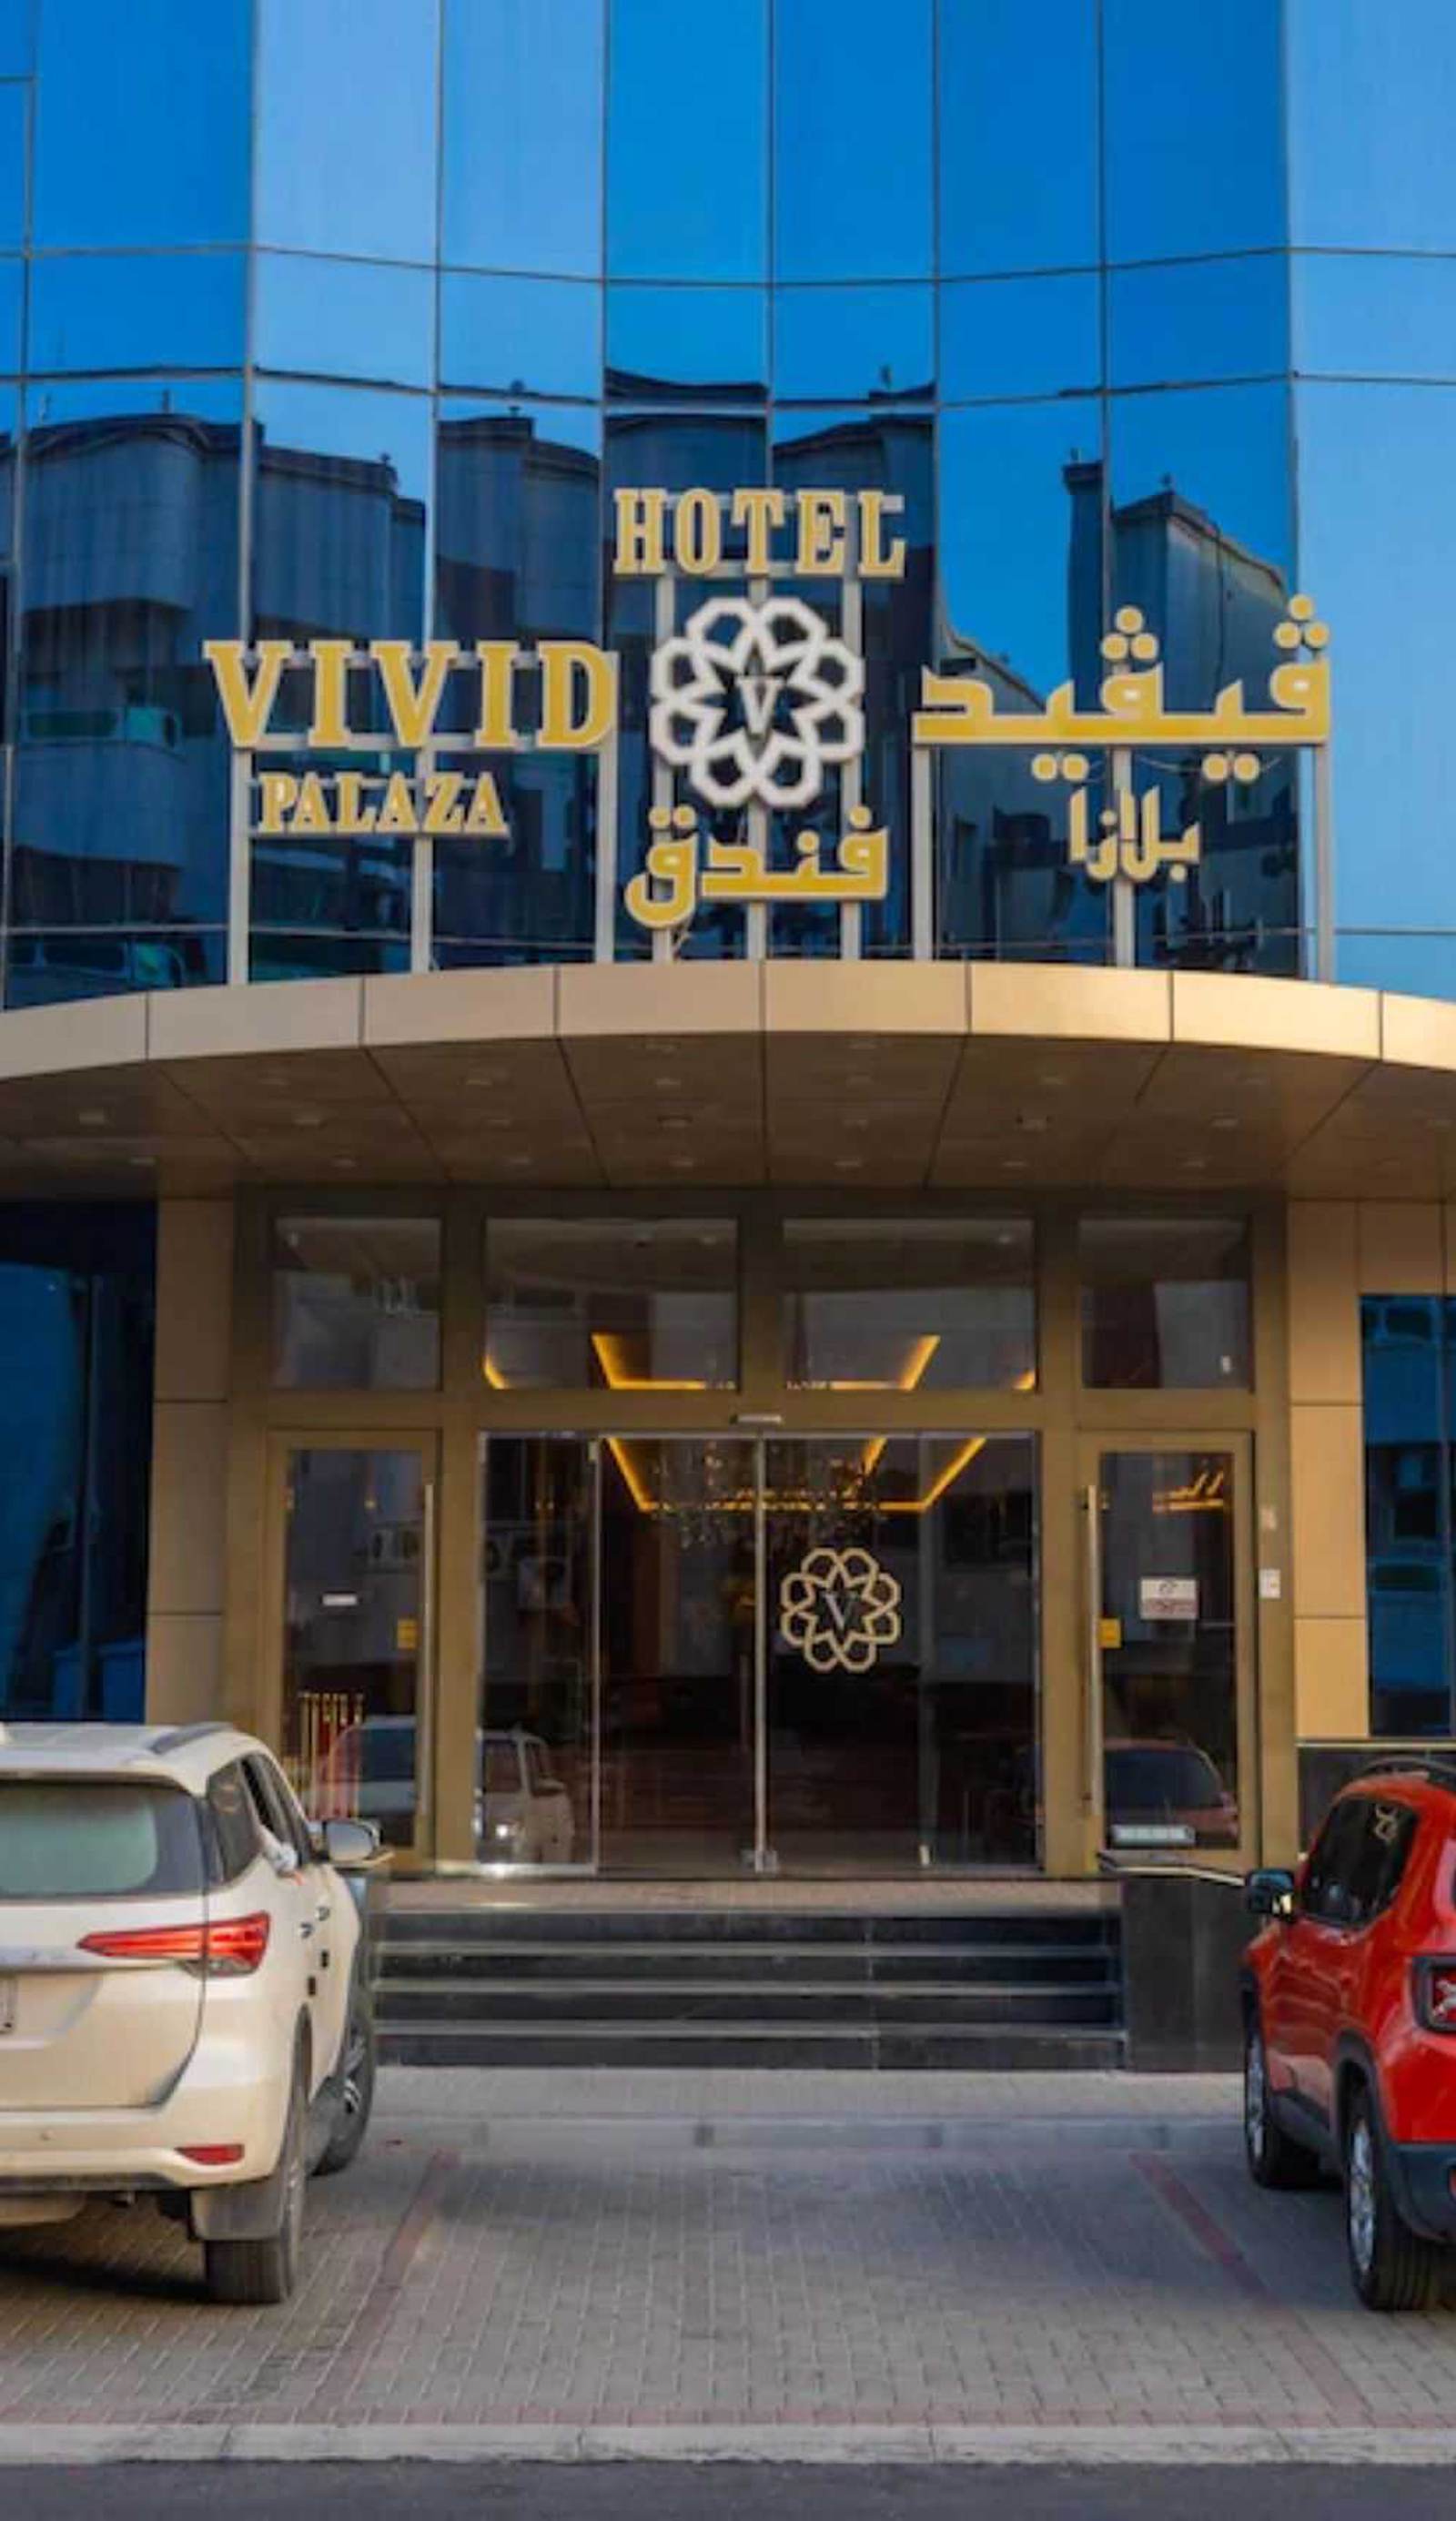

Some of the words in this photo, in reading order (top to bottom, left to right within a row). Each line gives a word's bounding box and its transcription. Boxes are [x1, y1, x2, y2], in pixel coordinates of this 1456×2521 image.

[613, 488, 905, 577] HOTEL
[202, 640, 618, 750] VIVID
[257, 771, 511, 835] PALAZA
[1068, 785, 1200, 883] بلازا
[624, 805, 889, 928] فندق
